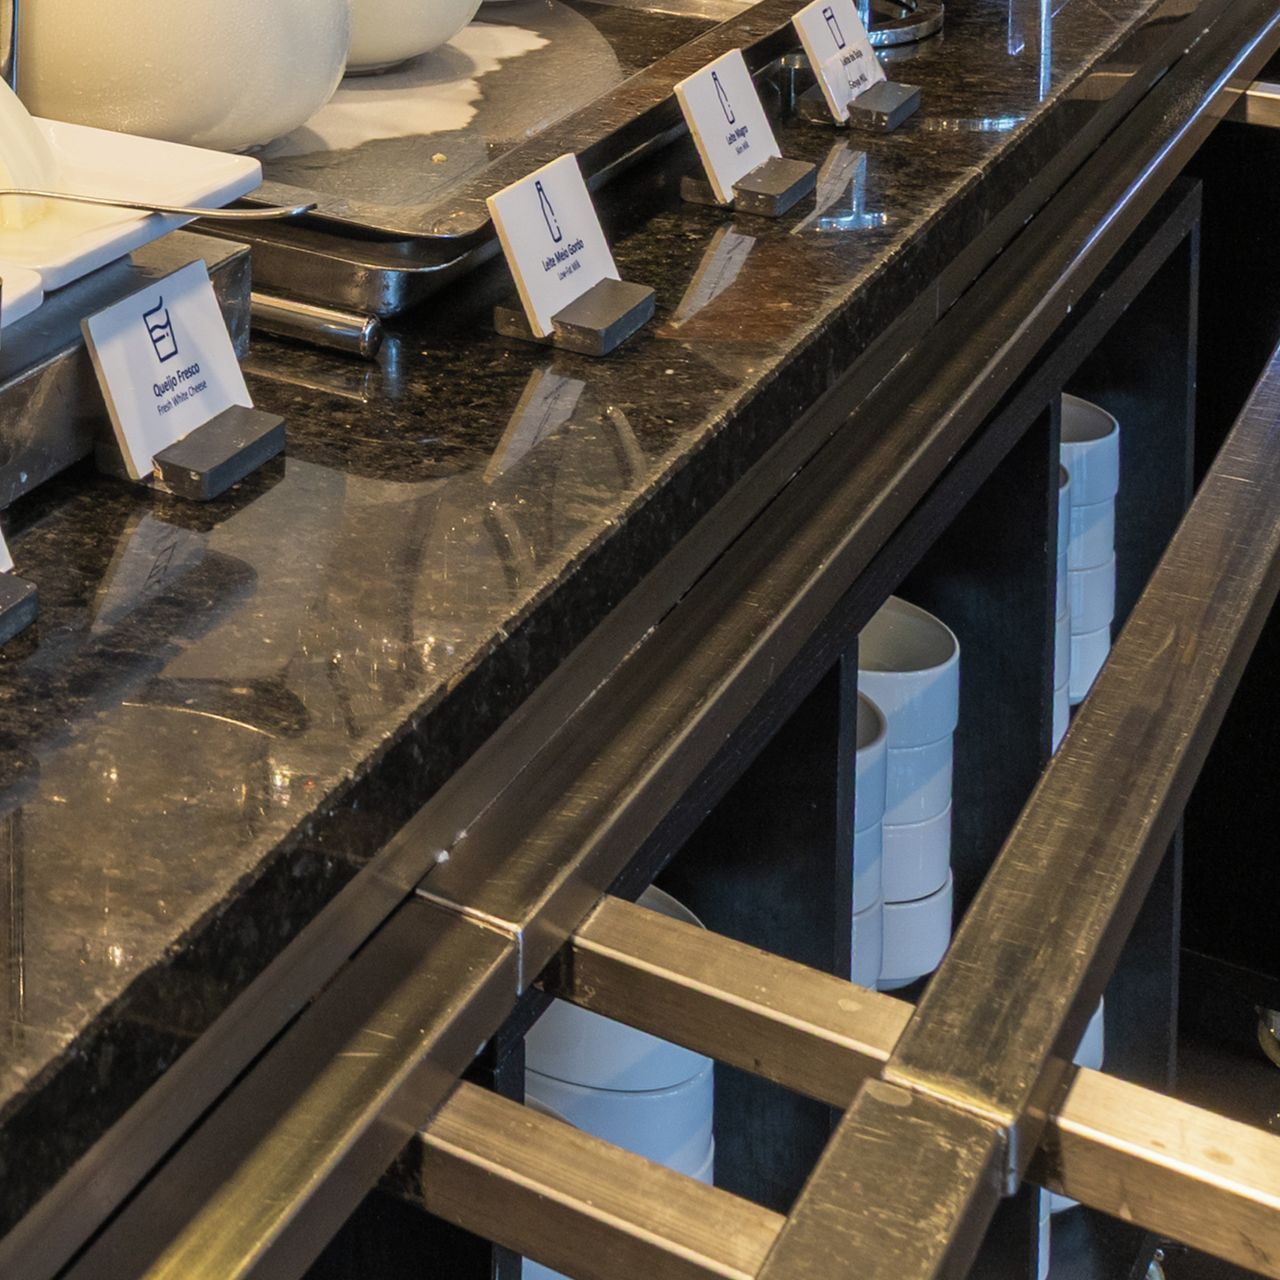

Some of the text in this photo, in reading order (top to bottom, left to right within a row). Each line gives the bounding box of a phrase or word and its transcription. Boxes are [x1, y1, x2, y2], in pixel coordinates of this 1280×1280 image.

[153, 363, 200, 397] Queijo Fresco
[188, 380, 207, 397] Cheese
